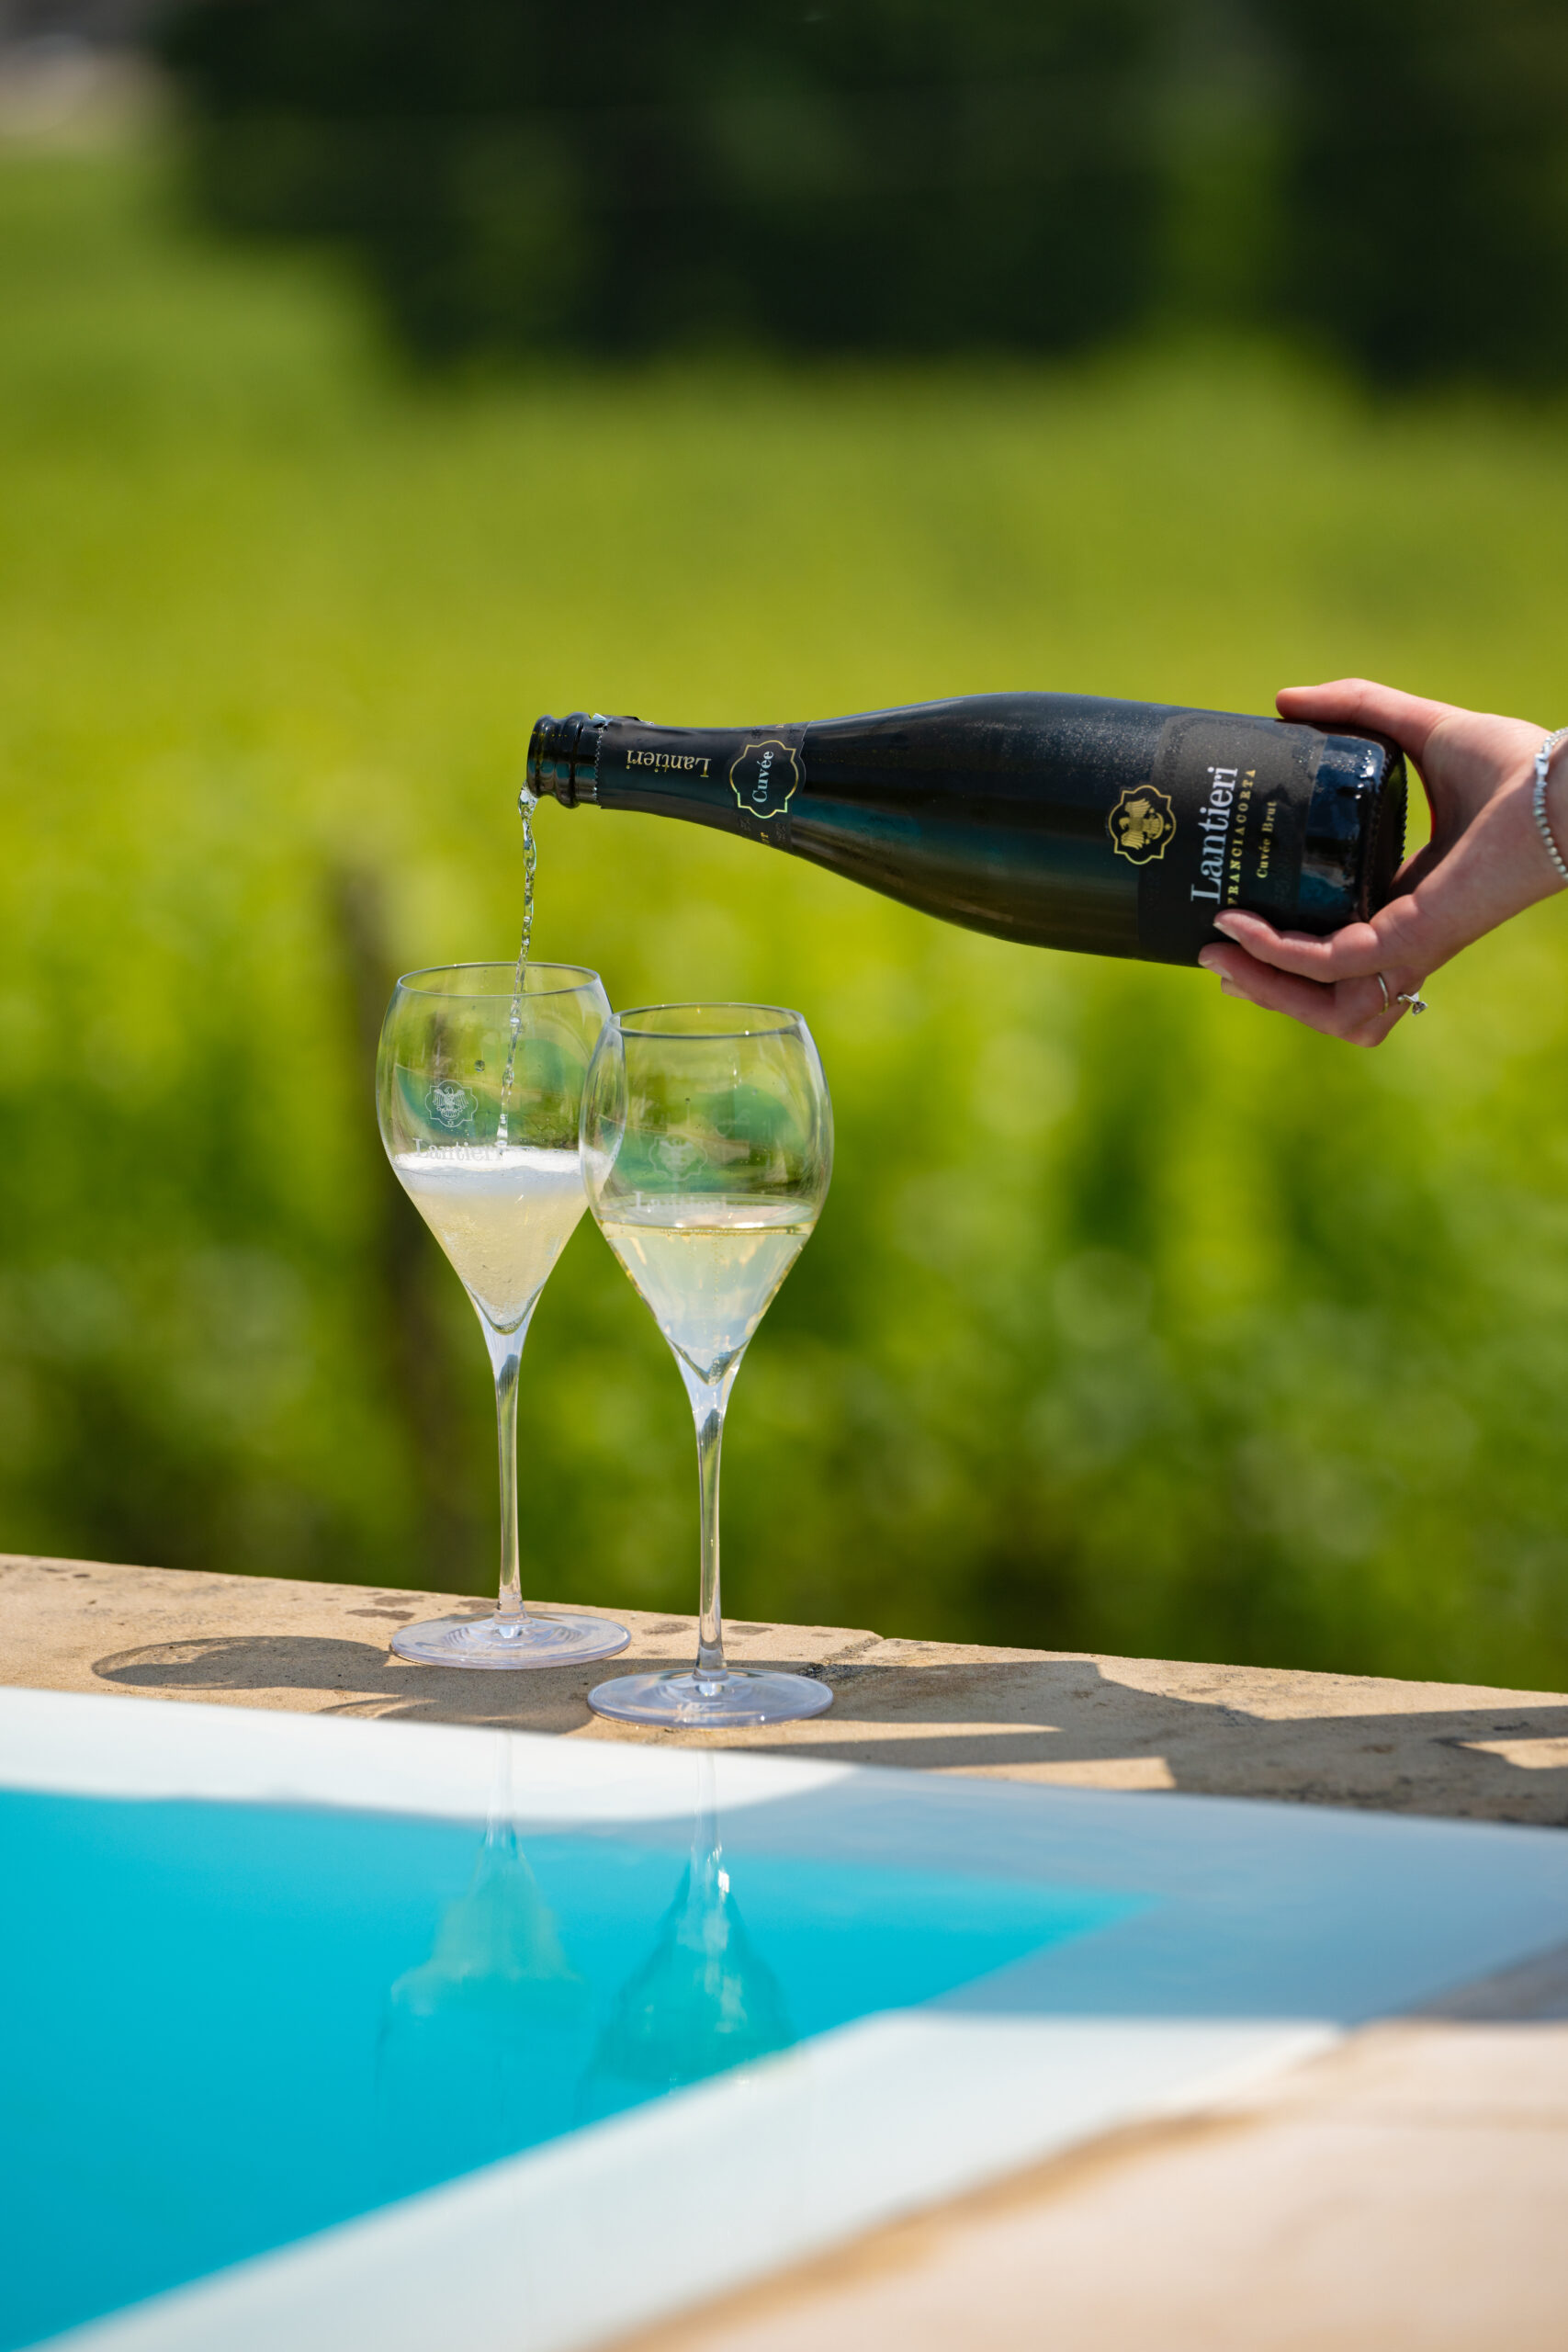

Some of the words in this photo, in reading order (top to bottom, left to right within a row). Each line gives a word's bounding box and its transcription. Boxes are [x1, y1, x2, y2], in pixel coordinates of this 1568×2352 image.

[626, 750, 712, 777] Lantieri
[752, 751, 774, 803] Cuvée
[1191, 766, 1238, 904] Lantieri
[1228, 770, 1256, 904] FRANCIACORTA
[1262, 801, 1277, 832] Brut
[1257, 838, 1271, 878] Cuvée
